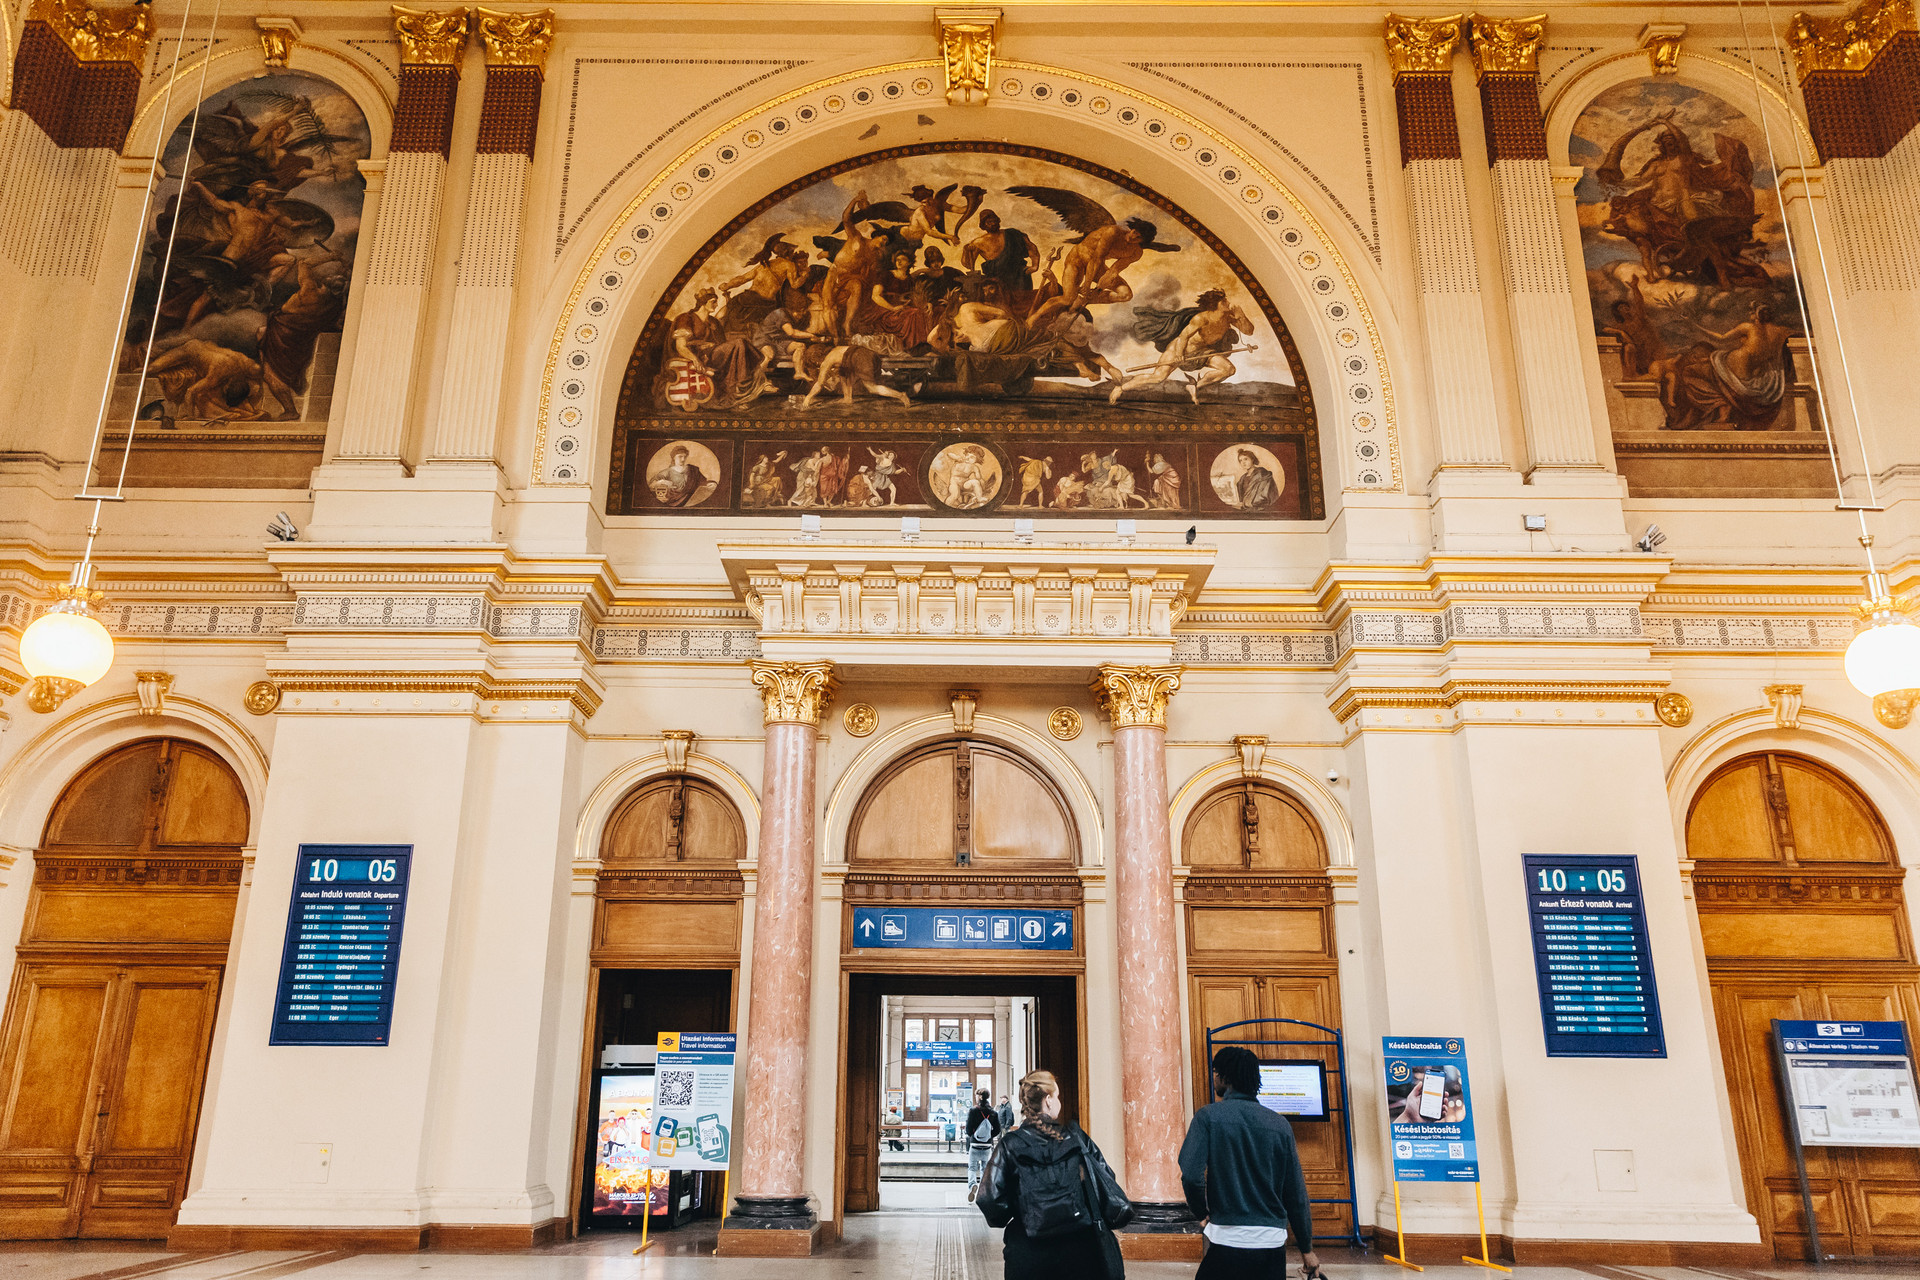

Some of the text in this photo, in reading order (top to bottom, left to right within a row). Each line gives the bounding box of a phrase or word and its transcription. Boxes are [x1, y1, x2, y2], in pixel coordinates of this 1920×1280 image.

[309, 859, 396, 882] 10 05
[1538, 869, 1567, 892] 10
[1597, 869, 1626, 892] 05
[322, 890, 343, 898] Induló
[1560, 898, 1584, 907] Érkező
[1586, 900, 1614, 908] vonatok
[1393, 1066, 1406, 1074] 10
[1394, 1125, 1461, 1134] Késési biztosítás
